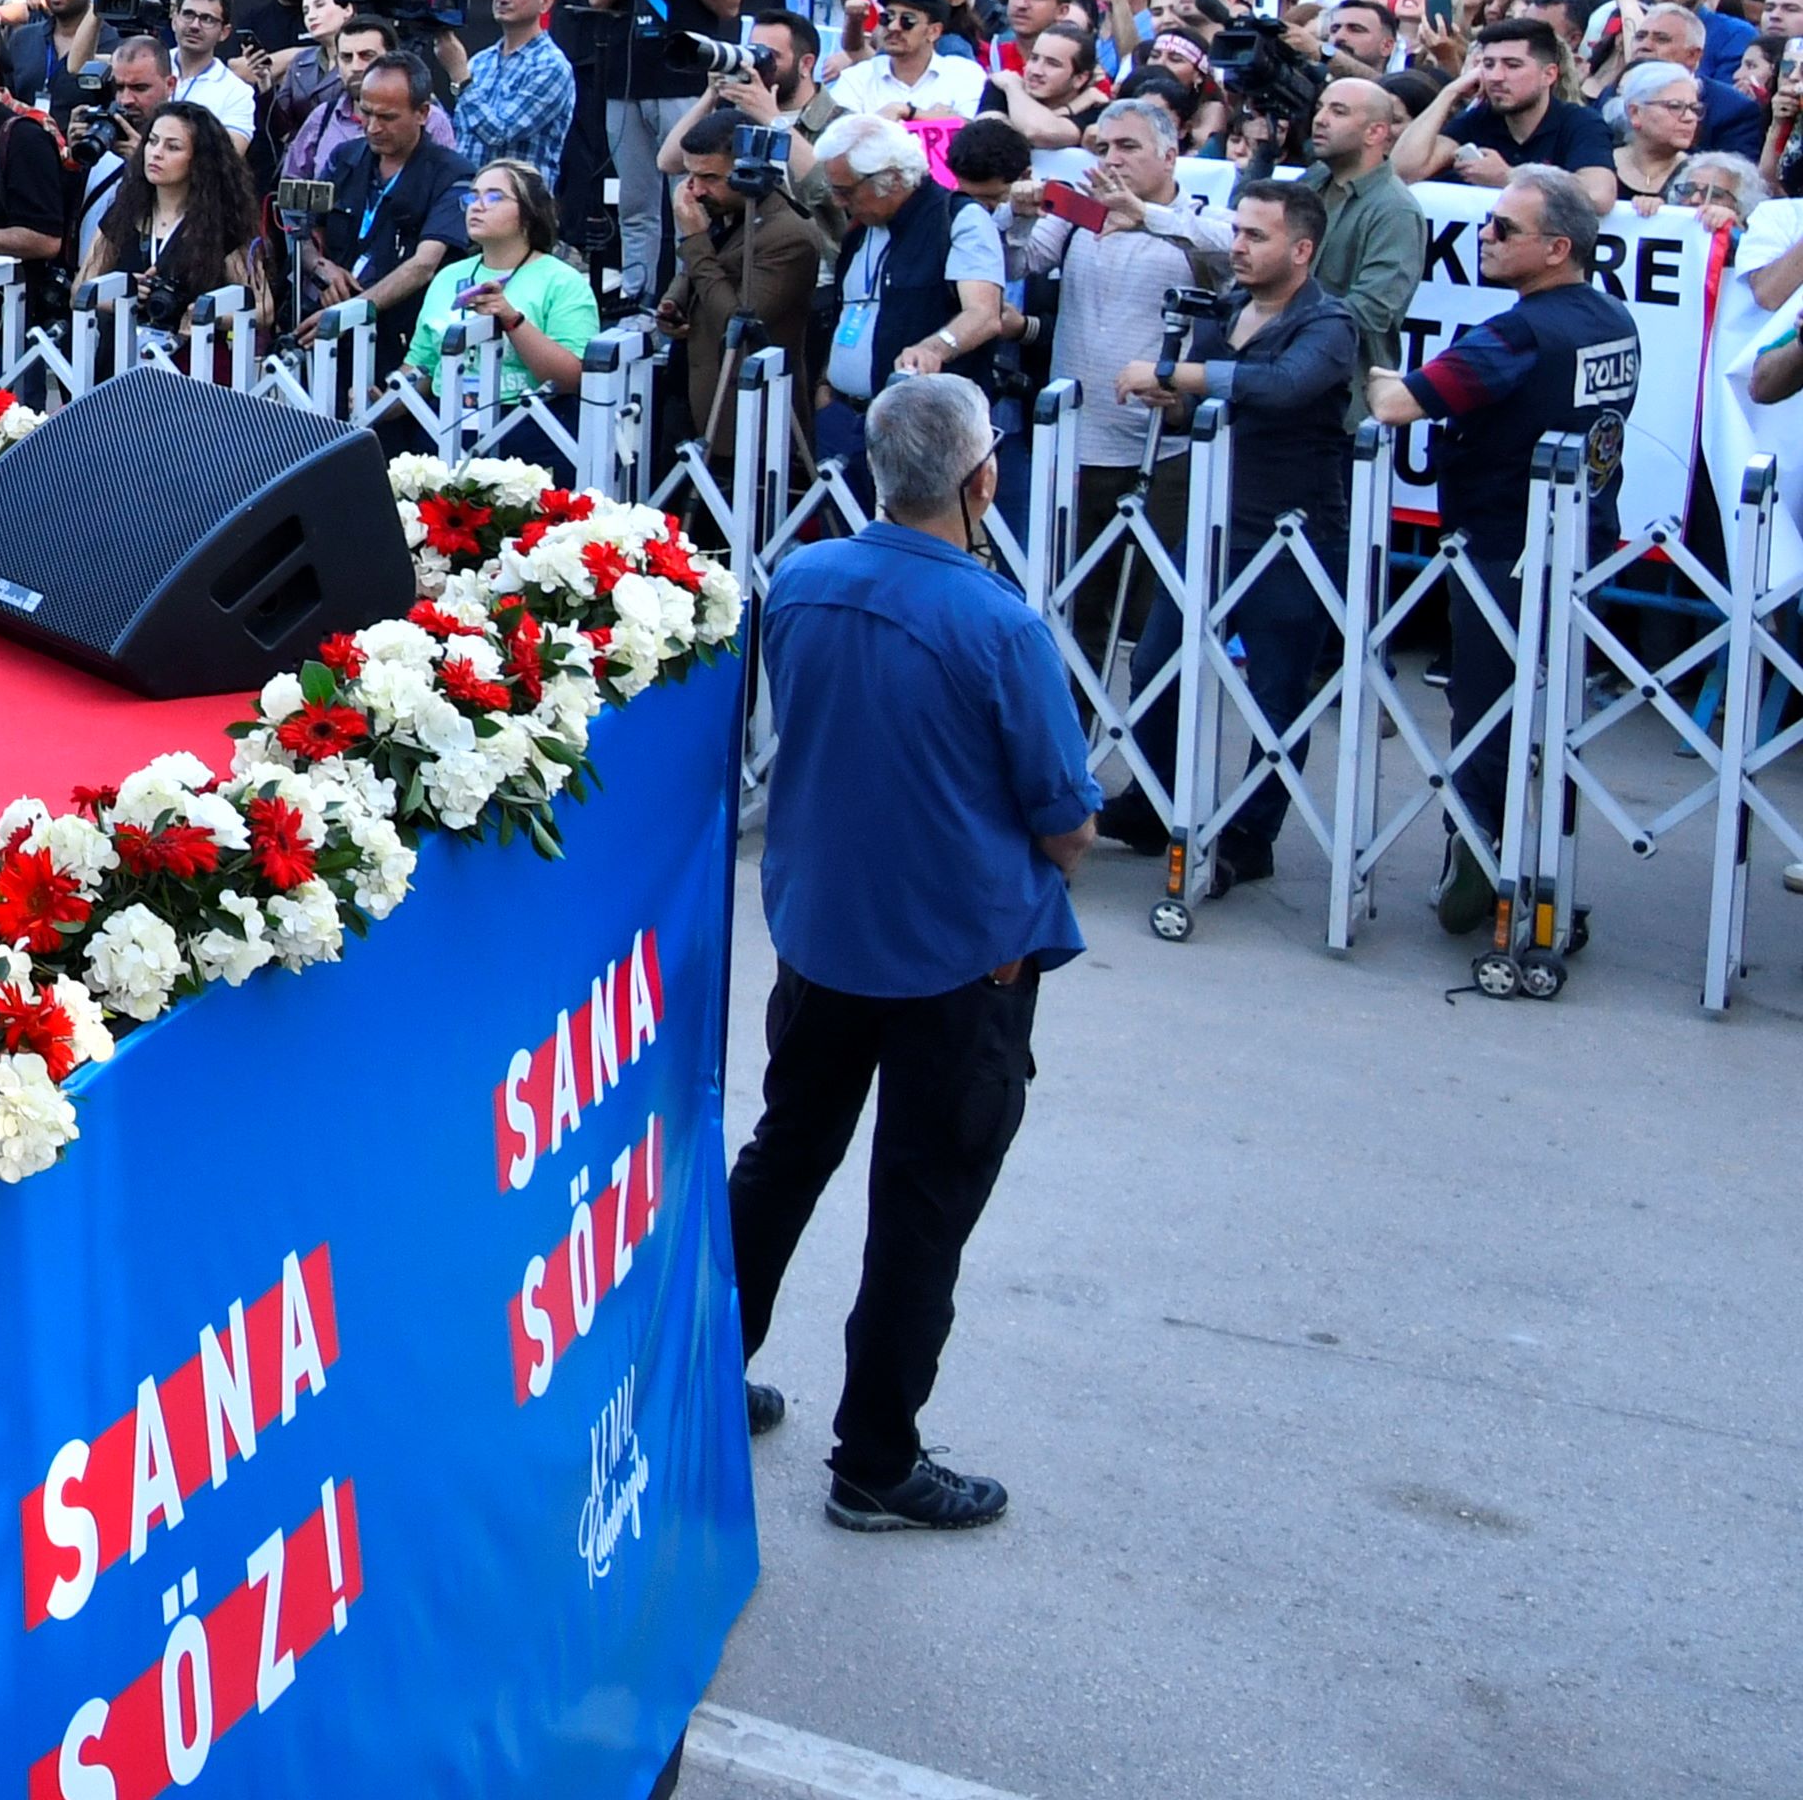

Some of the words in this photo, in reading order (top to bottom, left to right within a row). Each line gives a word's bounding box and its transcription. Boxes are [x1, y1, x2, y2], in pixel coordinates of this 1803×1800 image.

[504, 930, 657, 1190] SANA
[521, 1112, 662, 1396] SÖZ!
[43, 1250, 327, 1620] SANA
[57, 1477, 349, 1800] SÖZ!
